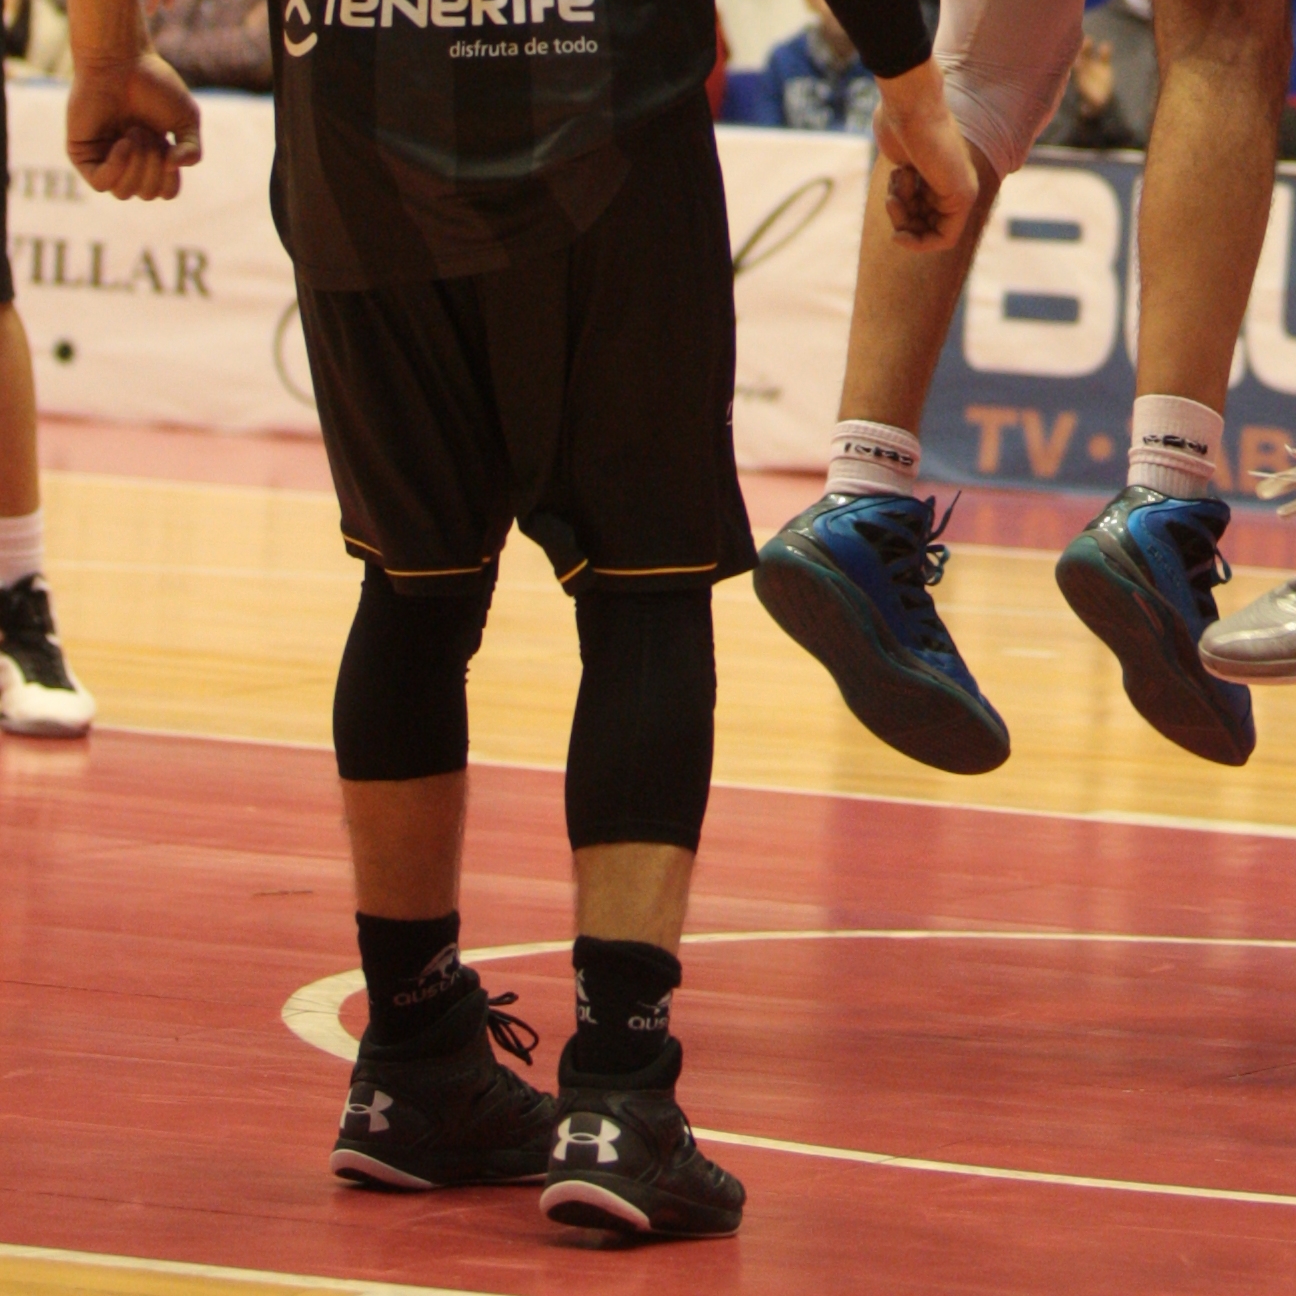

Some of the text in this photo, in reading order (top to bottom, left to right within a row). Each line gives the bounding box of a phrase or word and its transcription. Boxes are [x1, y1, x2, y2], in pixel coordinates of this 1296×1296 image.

[449, 36, 599, 58] disfruta de todo
[9, 165, 87, 205] TEL
[965, 405, 1078, 479] TV
